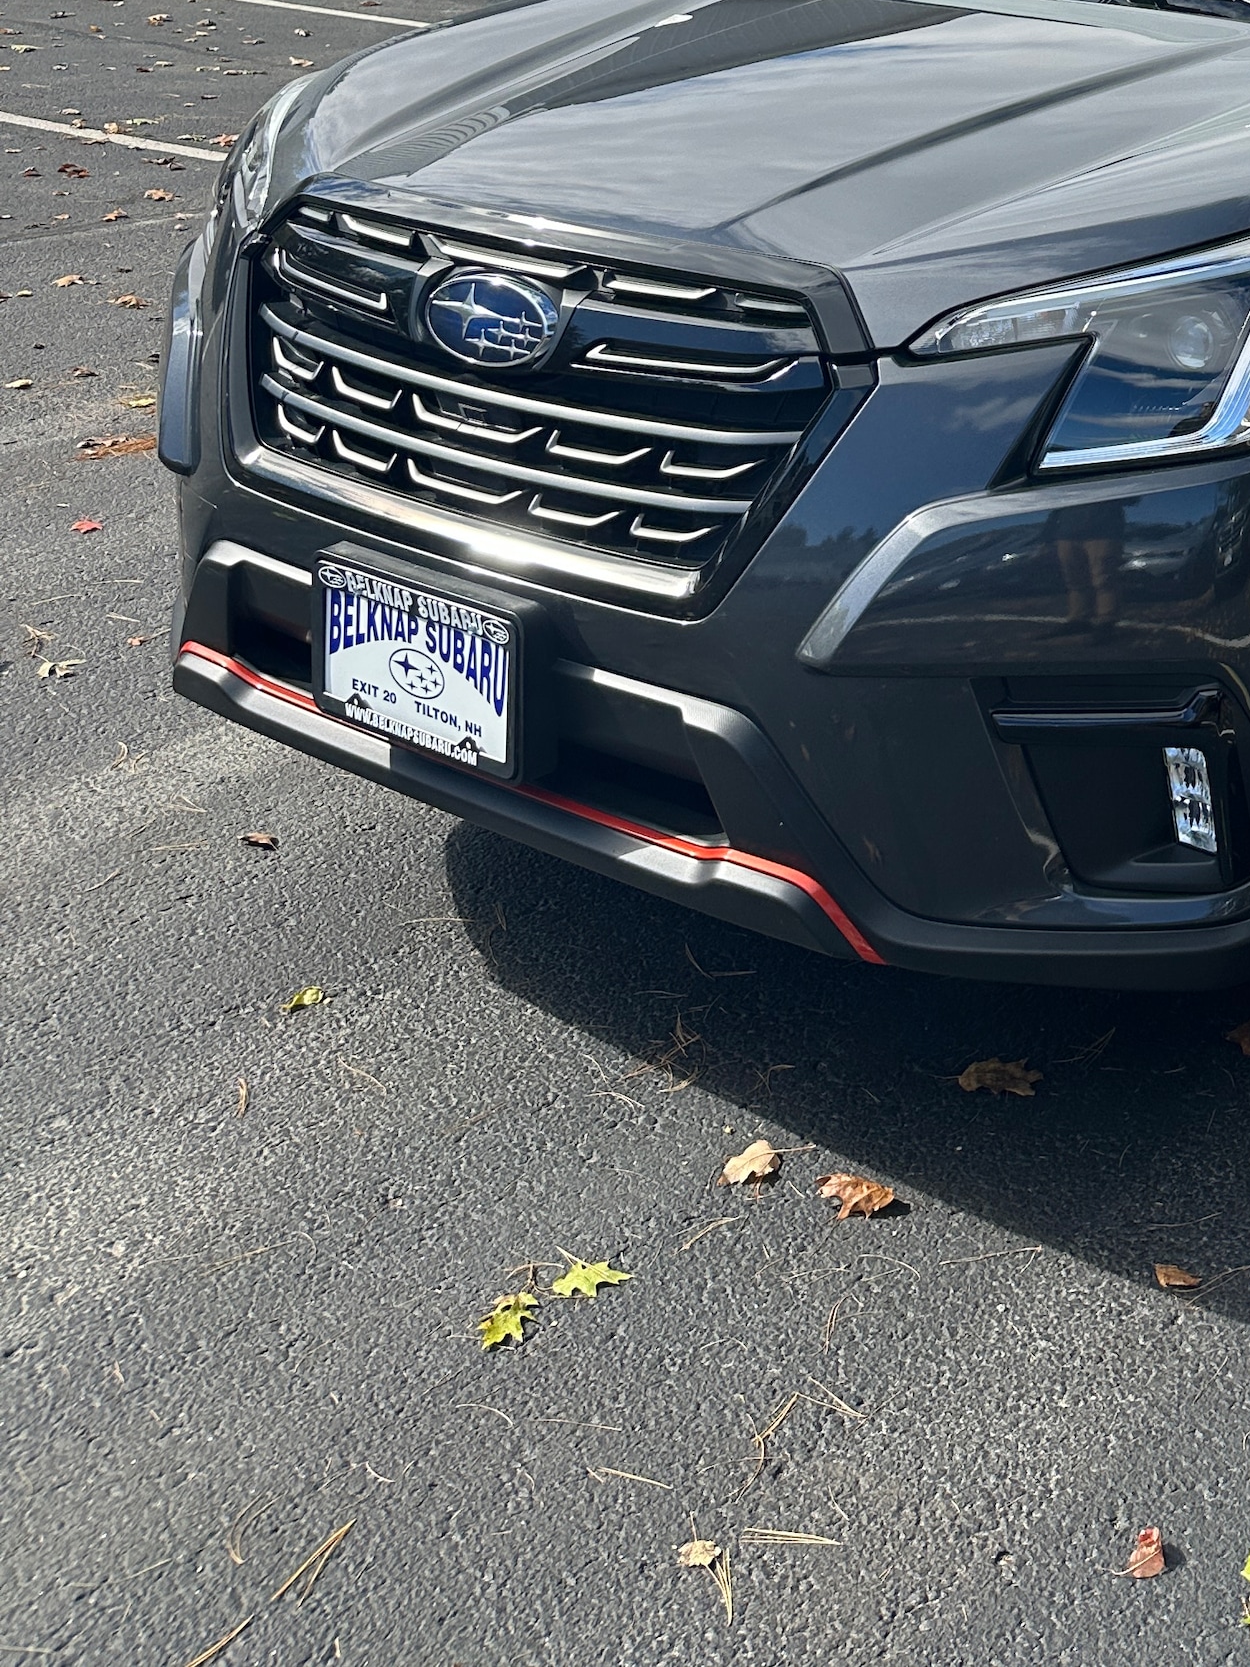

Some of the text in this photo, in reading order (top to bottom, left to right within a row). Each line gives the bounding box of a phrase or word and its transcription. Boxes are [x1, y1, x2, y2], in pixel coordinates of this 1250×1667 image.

[345, 571, 484, 636] BELKNAP SUBARU
[330, 588, 507, 717] BELKNAP SUBARU
[352, 678, 397, 704] EXIT 20
[414, 700, 482, 737] TILTON, NH
[345, 702, 478, 766] WWW.BELKNAPSUBARU.COM
